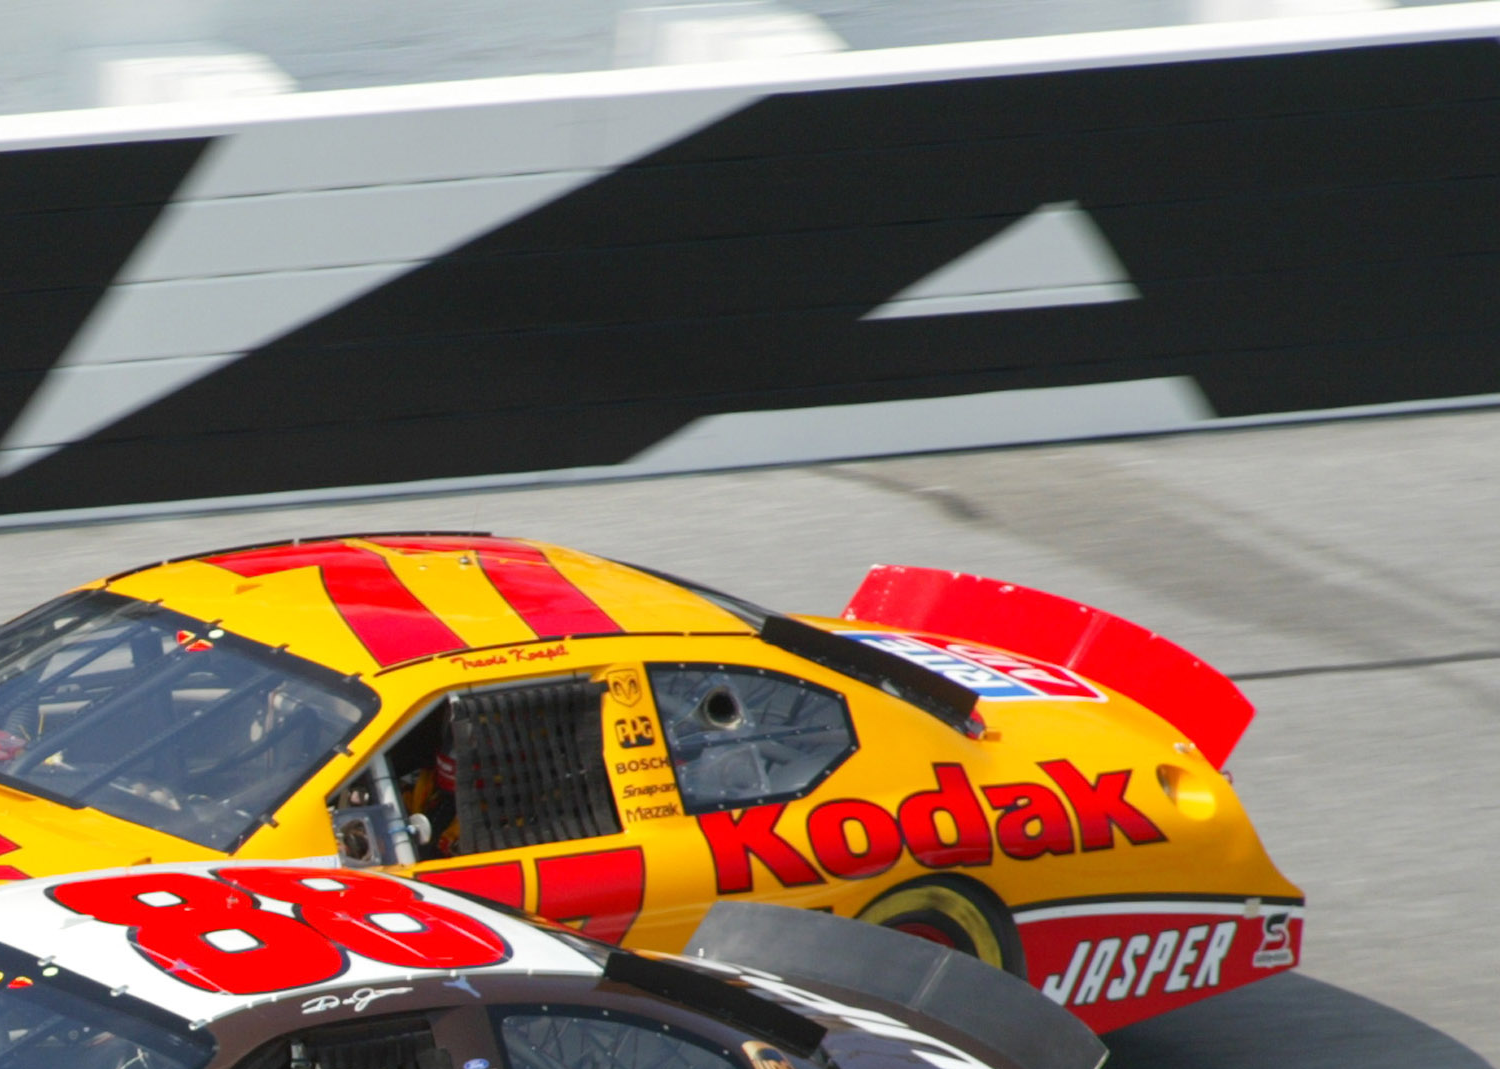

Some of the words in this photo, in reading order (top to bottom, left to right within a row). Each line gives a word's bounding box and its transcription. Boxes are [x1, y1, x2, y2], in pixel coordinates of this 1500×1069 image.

[617, 717, 653, 745] PPG
[616, 757, 669, 774] BOSCH
[626, 802, 681, 823] Mazak
[699, 759, 1167, 894] Kodak
[48, 866, 513, 995] 88
[1041, 920, 1238, 1007] JASPER
